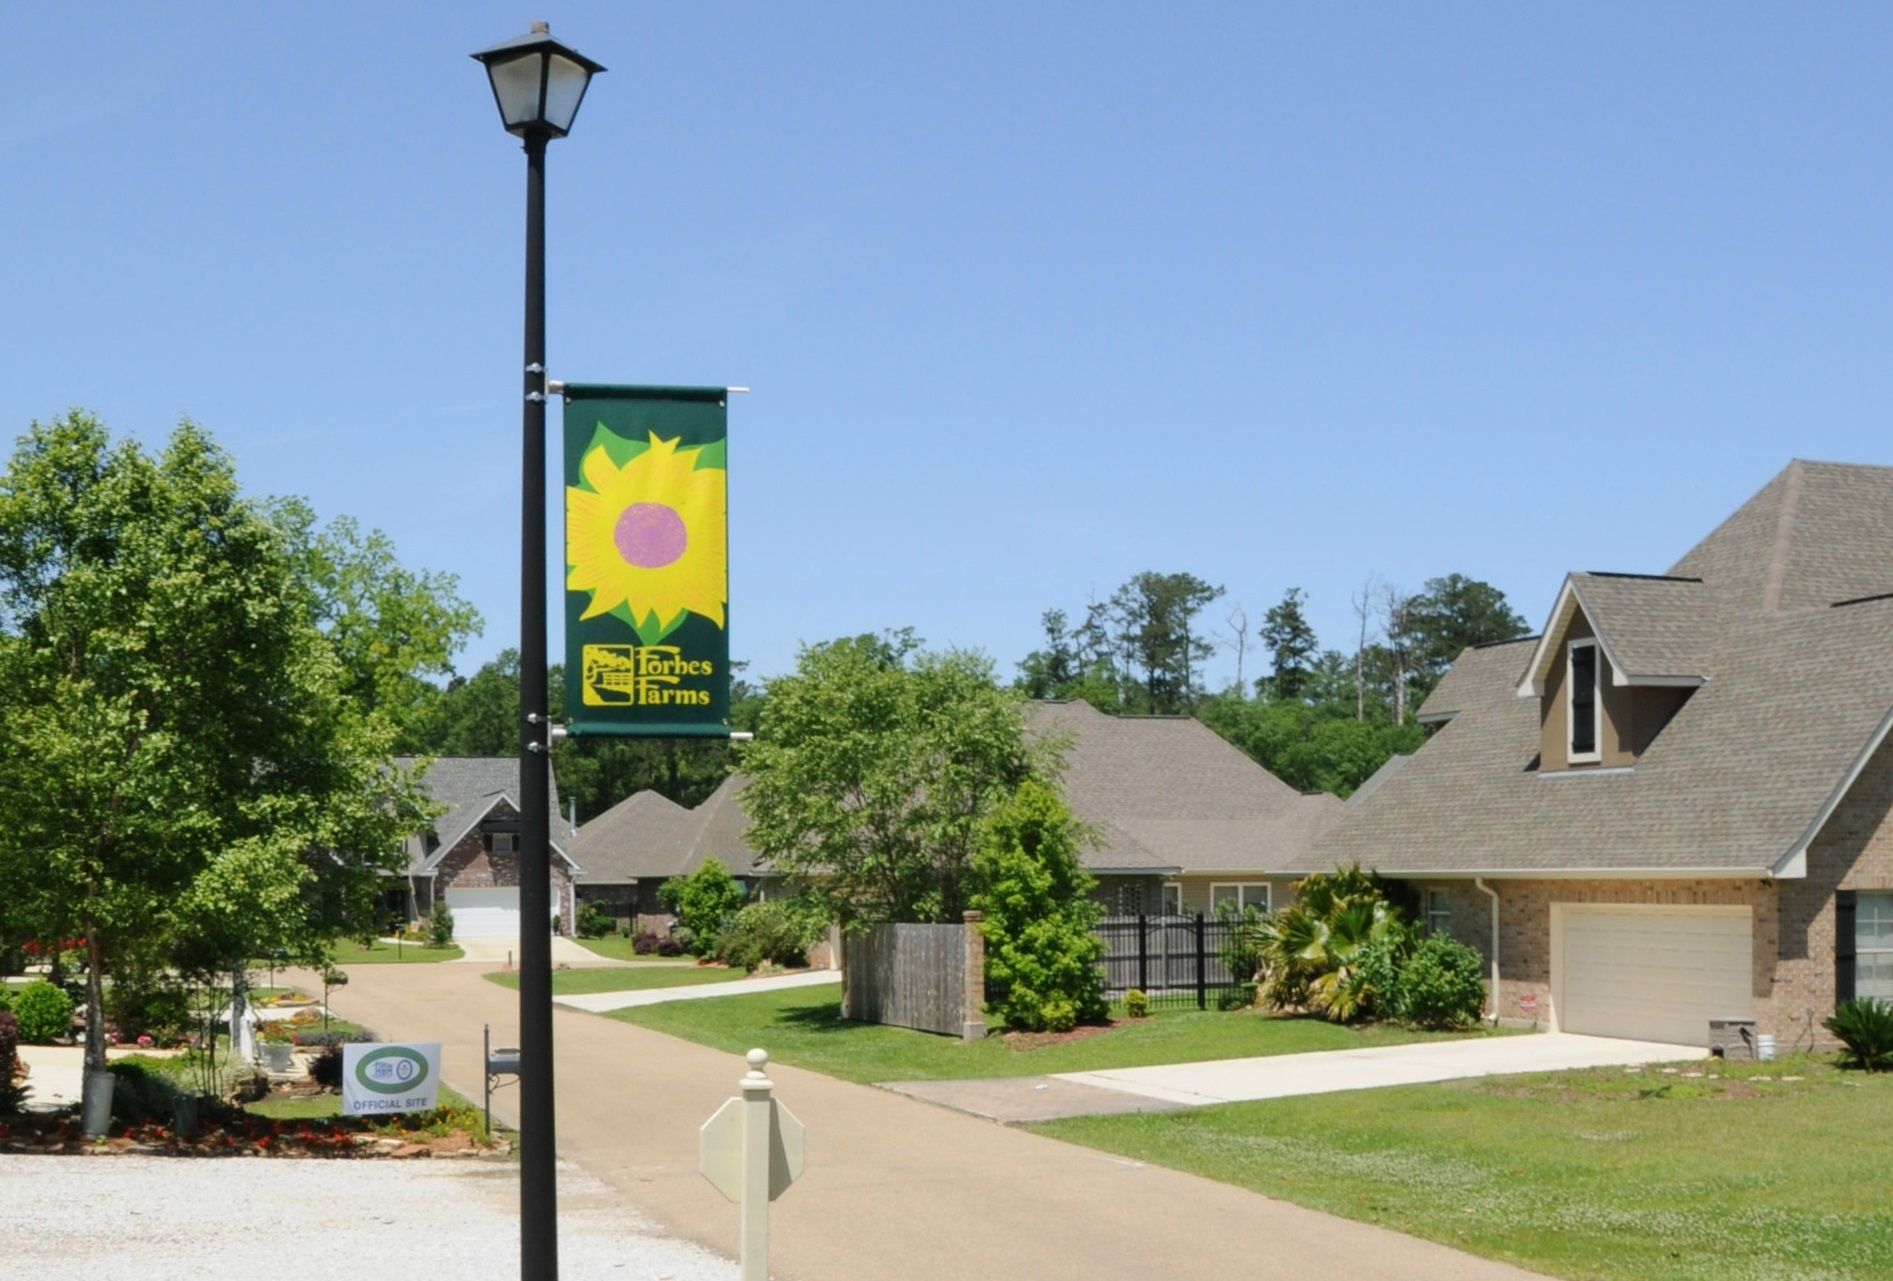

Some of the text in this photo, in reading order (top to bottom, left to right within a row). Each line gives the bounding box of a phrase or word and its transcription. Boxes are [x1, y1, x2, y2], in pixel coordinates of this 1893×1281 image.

[635, 646, 713, 675] Forbes
[635, 676, 711, 705] Farms
[354, 1098, 427, 1110] OFFICIAL SITE
